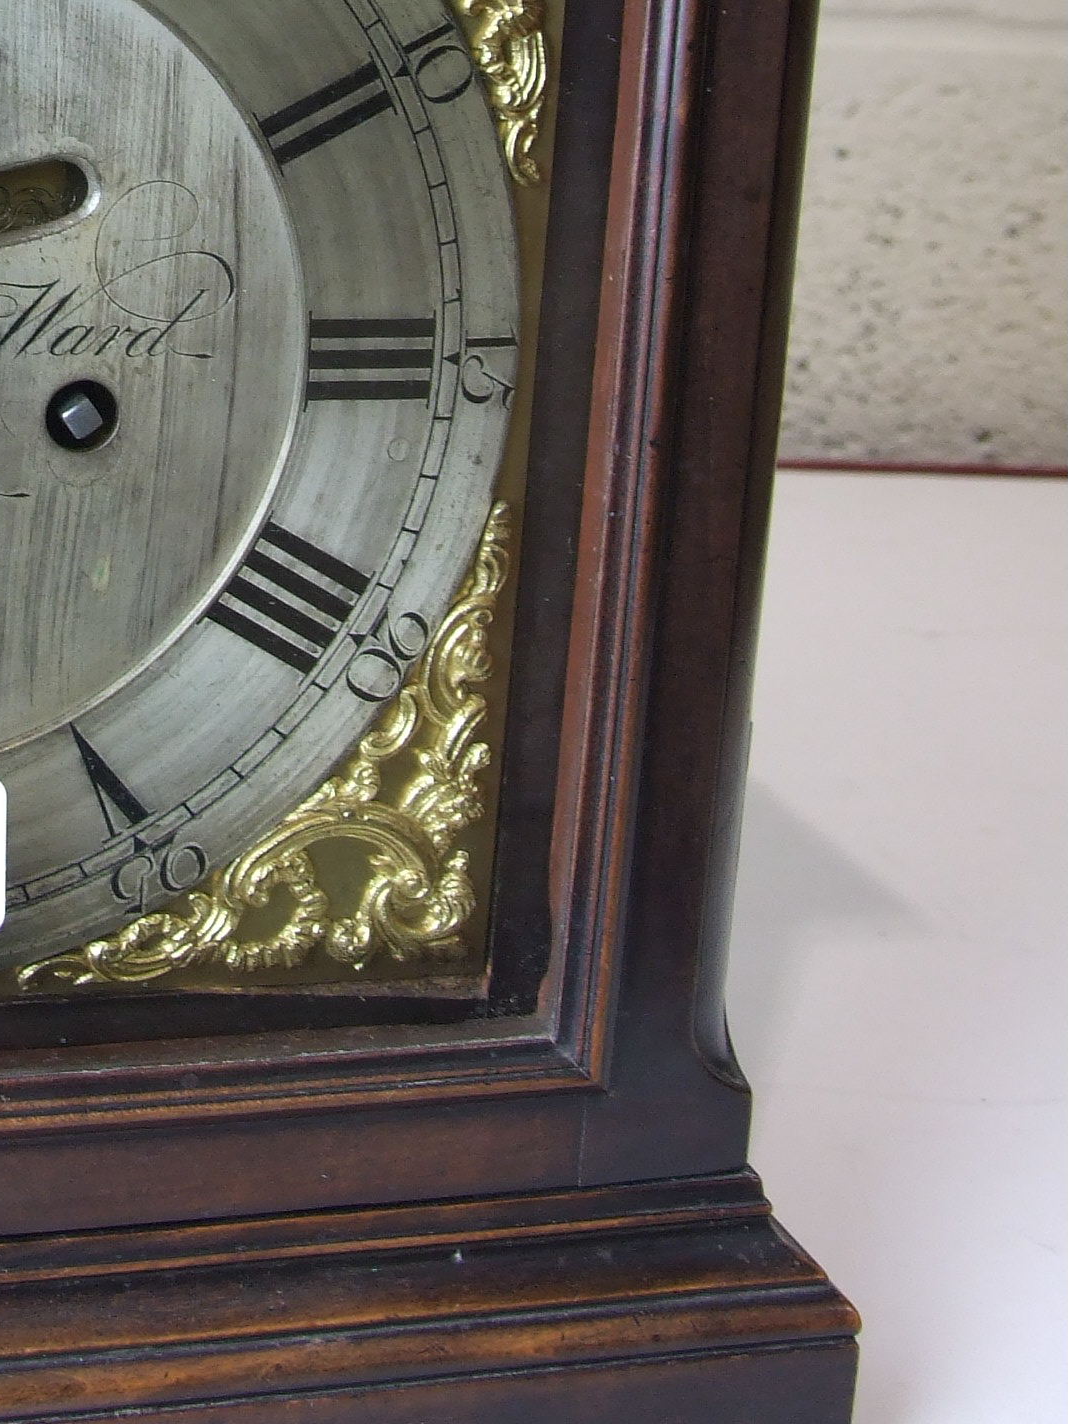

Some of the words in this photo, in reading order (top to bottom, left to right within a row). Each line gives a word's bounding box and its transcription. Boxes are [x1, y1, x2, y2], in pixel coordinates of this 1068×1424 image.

[403, 21, 475, 104] 10
[253, 51, 398, 174] II
[303, 309, 438, 413] III
[461, 327, 520, 412] 15
[345, 610, 430, 702] 20
[68, 721, 155, 841] V
[111, 840, 210, 914] 25
